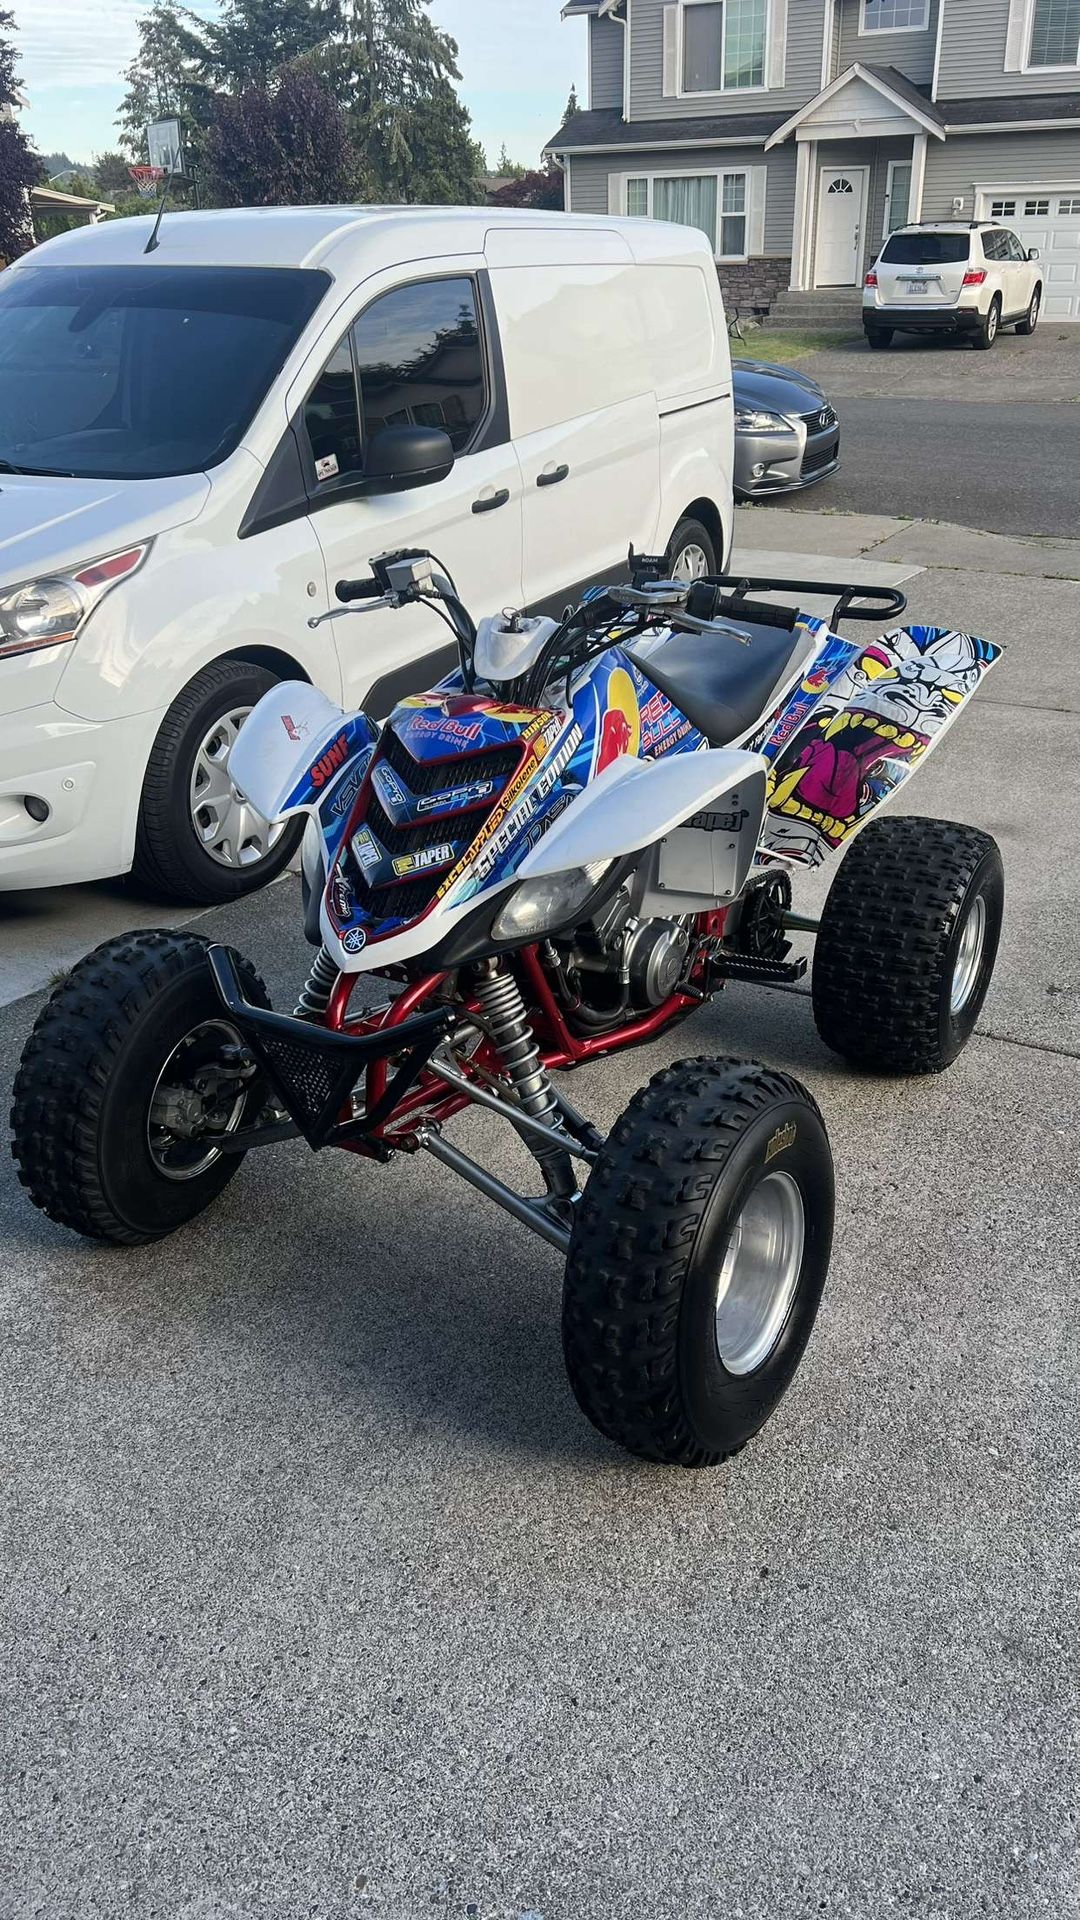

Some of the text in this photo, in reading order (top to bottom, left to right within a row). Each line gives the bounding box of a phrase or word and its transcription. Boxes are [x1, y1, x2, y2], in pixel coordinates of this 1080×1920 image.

[411, 715, 482, 740] Red Bull
[641, 712, 682, 752] BULL
[768, 701, 811, 746] Red Bull
[310, 733, 349, 788] SUNF
[654, 731, 679, 757] ENERGY
[381, 767, 404, 802] GoPro
[420, 783, 491, 805] GoPro
[480, 796, 539, 878] SPECIAL
[537, 721, 584, 799] EDITION
[501, 759, 537, 808] Silkolene
[413, 845, 450, 867] TAPER
[436, 853, 473, 899] EXCEL
